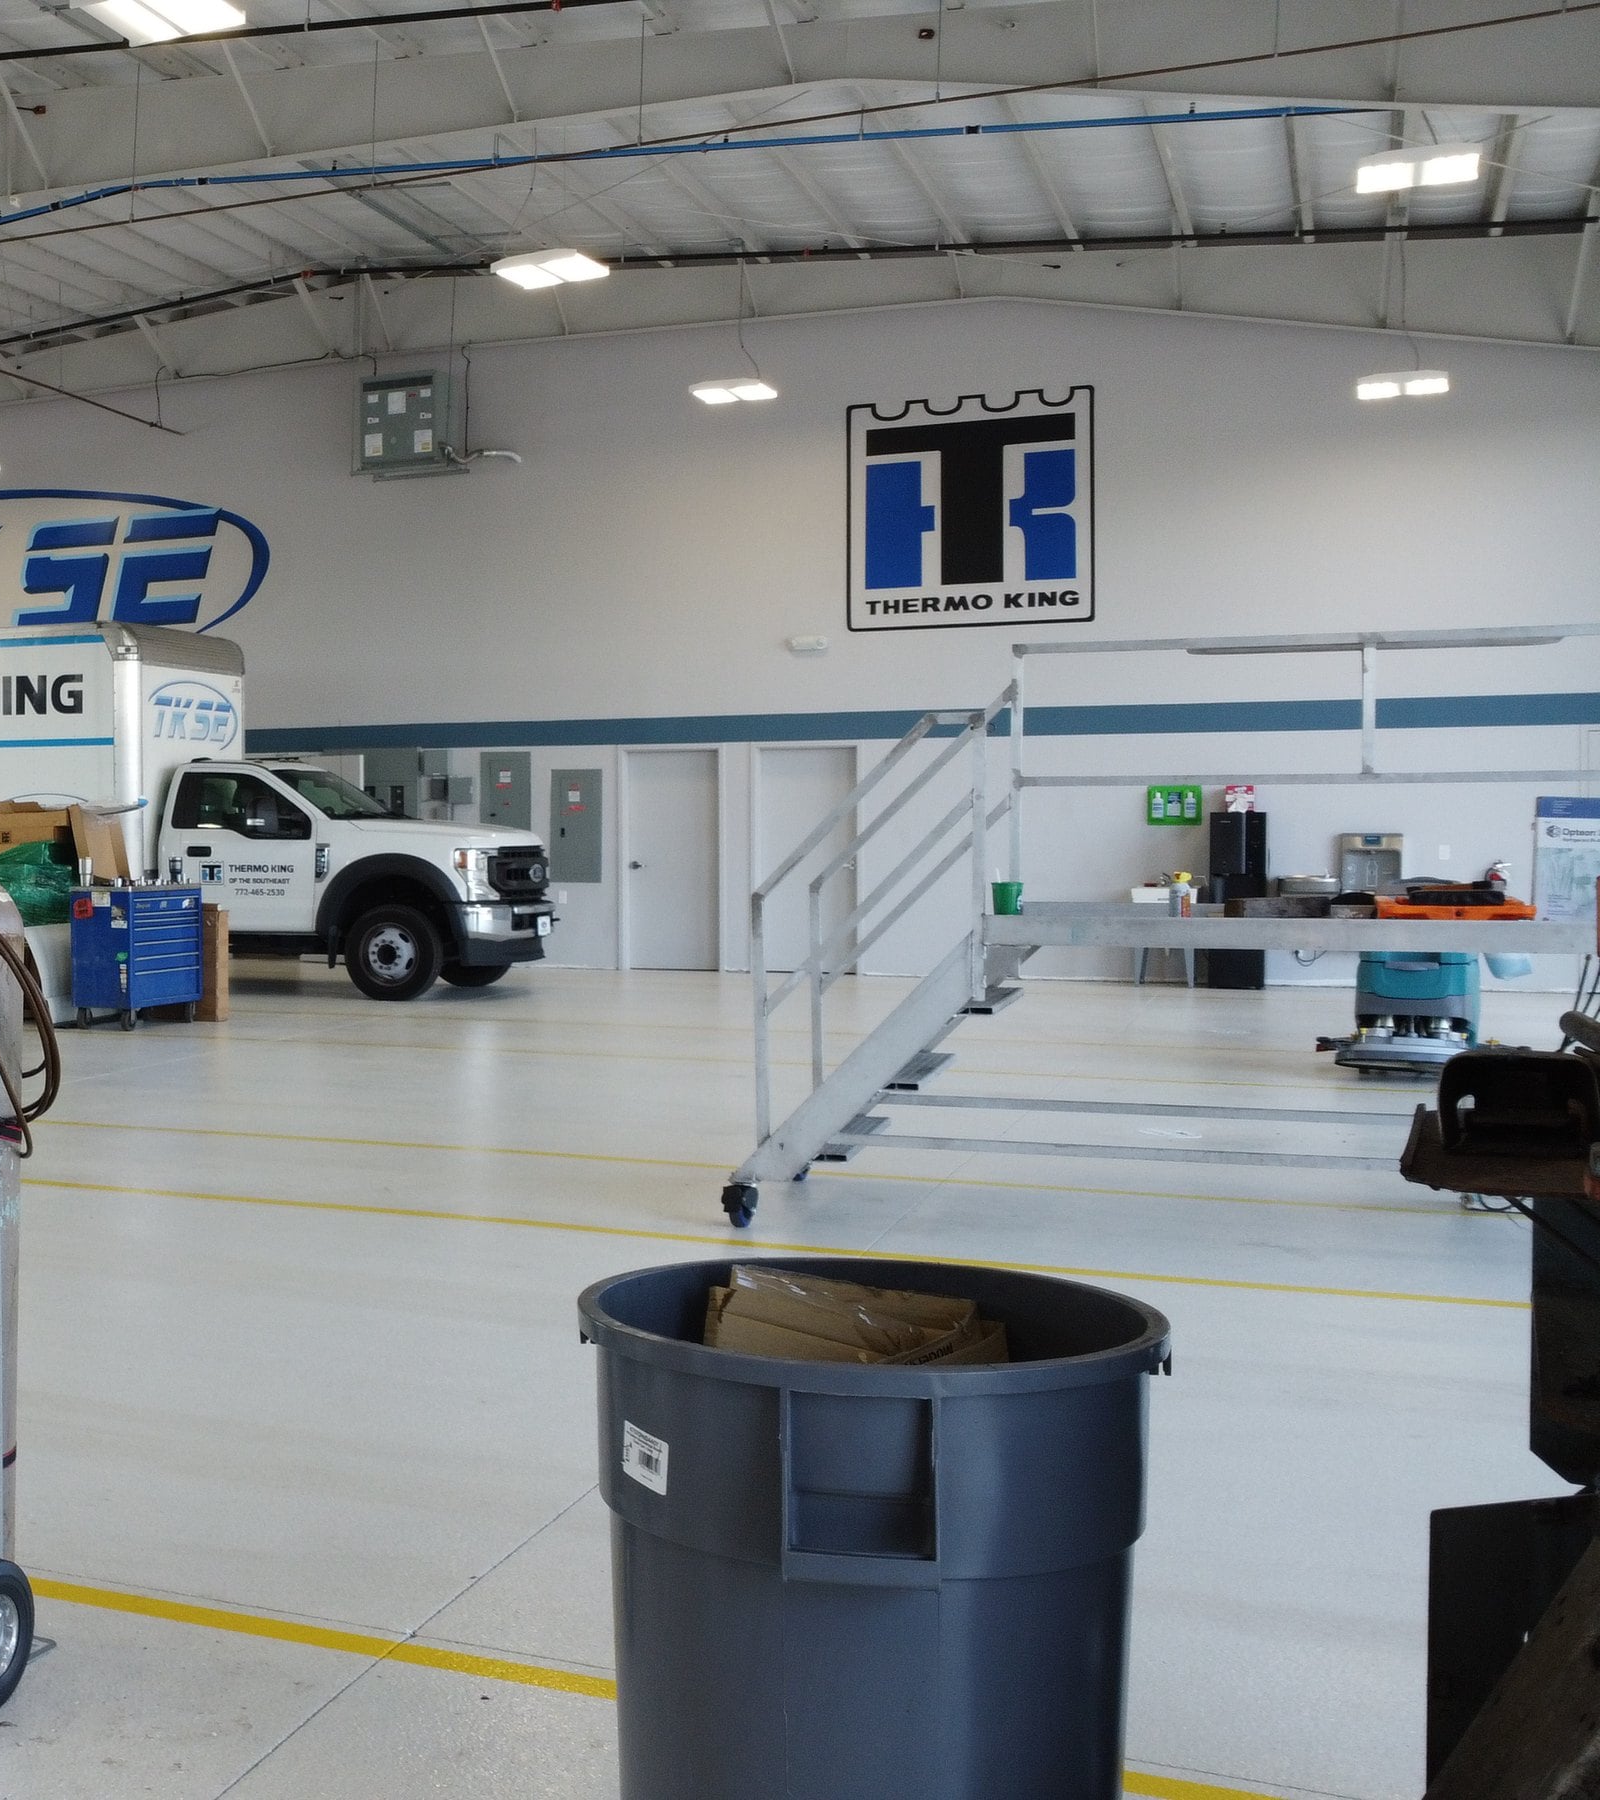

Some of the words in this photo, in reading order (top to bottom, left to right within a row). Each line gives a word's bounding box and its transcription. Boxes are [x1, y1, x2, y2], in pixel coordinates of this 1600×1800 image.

[865, 593, 994, 615] THERMO
[1003, 590, 1080, 609] KING
[228, 864, 269, 873] THERMO
[271, 864, 294, 873] KING
[234, 888, 285, 896] 772-465-2530
